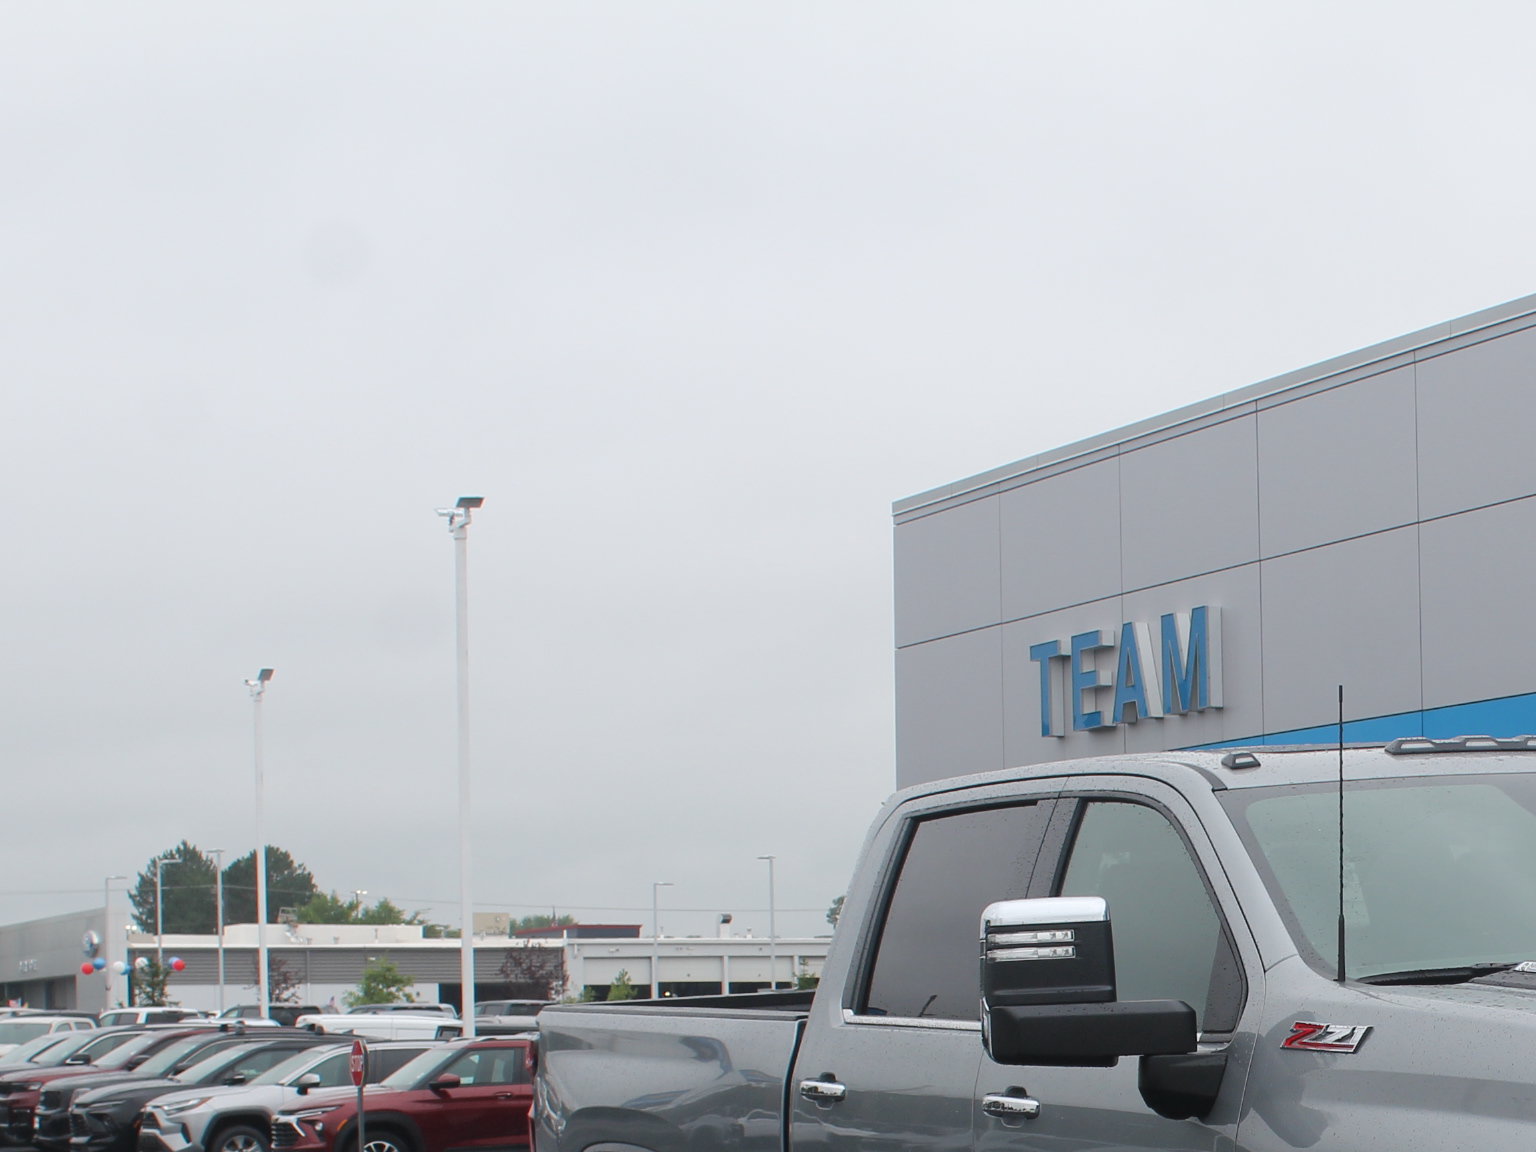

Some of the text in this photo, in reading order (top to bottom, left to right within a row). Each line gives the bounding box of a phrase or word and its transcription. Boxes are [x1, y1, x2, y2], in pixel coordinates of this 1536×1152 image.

[1029, 605, 1223, 737] TEAM
[1280, 1020, 1373, 1053] Z71
[351, 1054, 364, 1072] STOP
